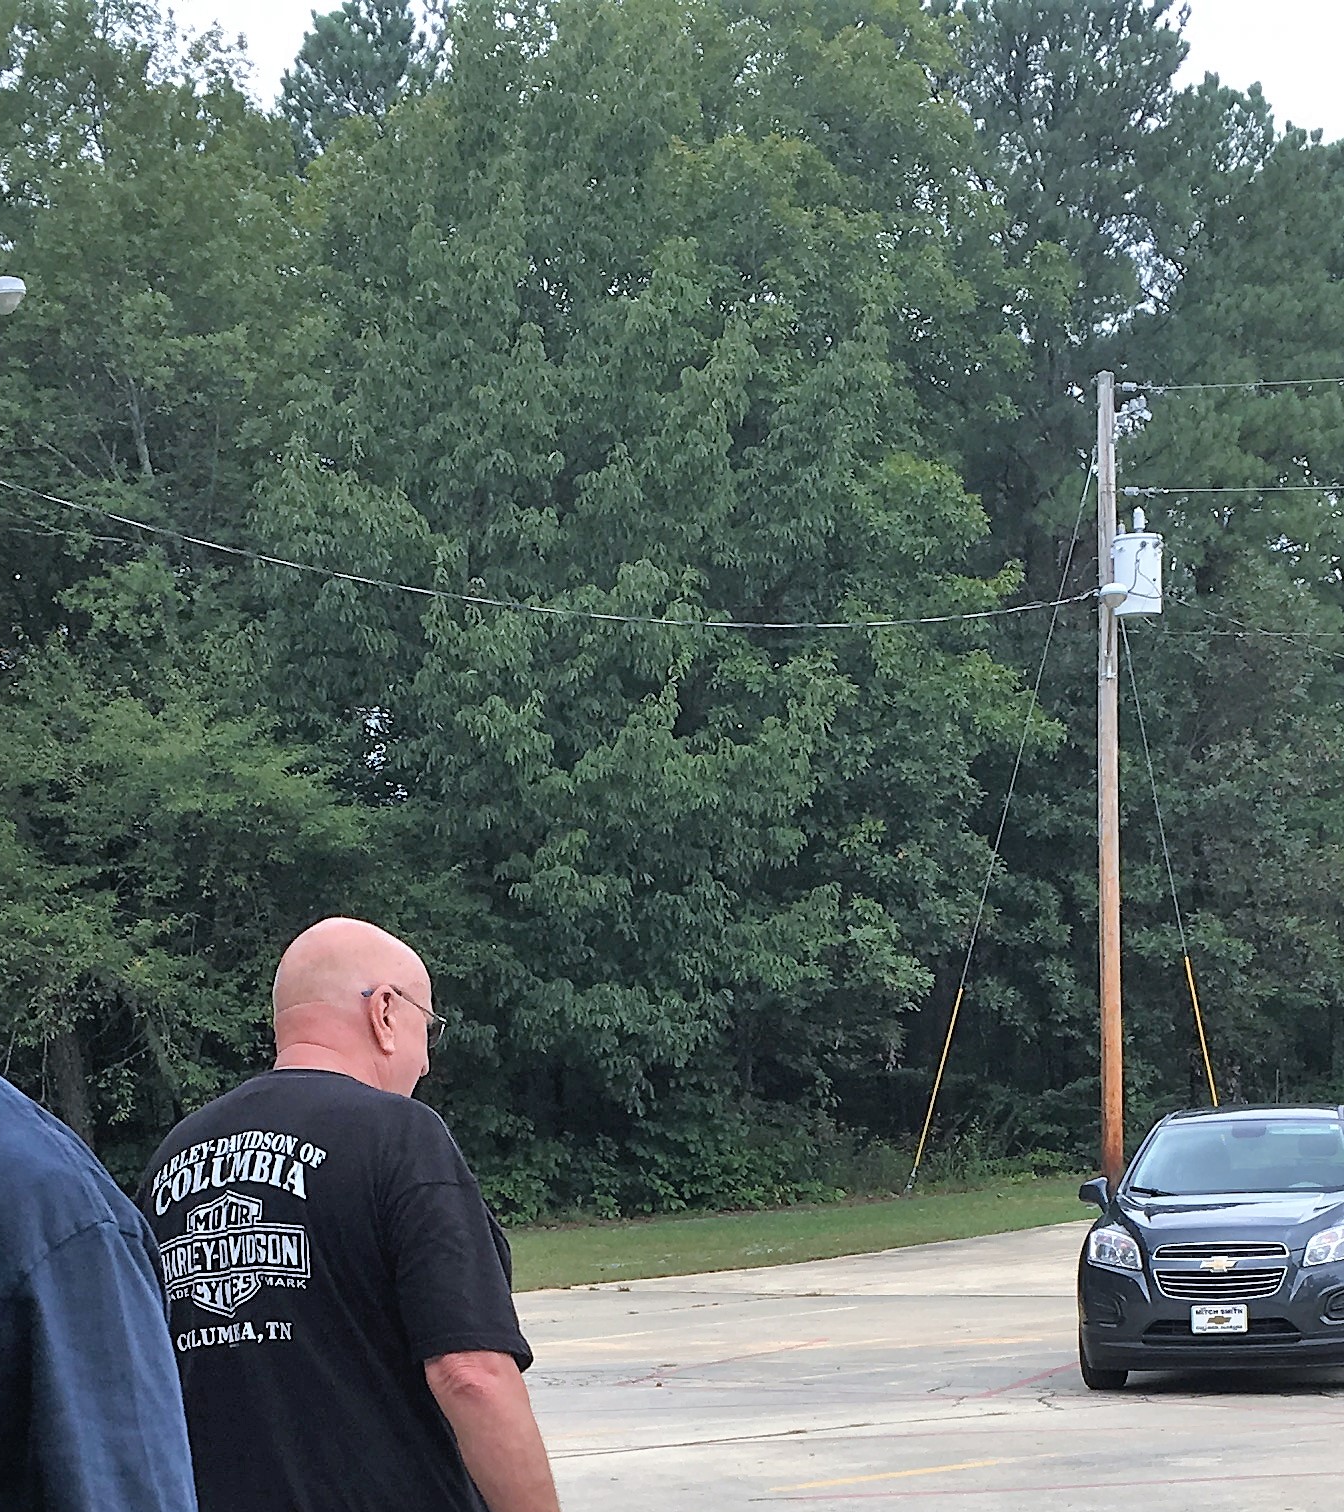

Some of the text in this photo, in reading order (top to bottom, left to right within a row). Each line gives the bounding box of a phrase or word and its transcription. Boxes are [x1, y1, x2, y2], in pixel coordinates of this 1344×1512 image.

[299, 1142, 327, 1169] OF
[155, 1150, 307, 1216] COLUMBIA
[161, 1233, 299, 1284] HARLEY-DVIDSON
[265, 1321, 293, 1341] TN
